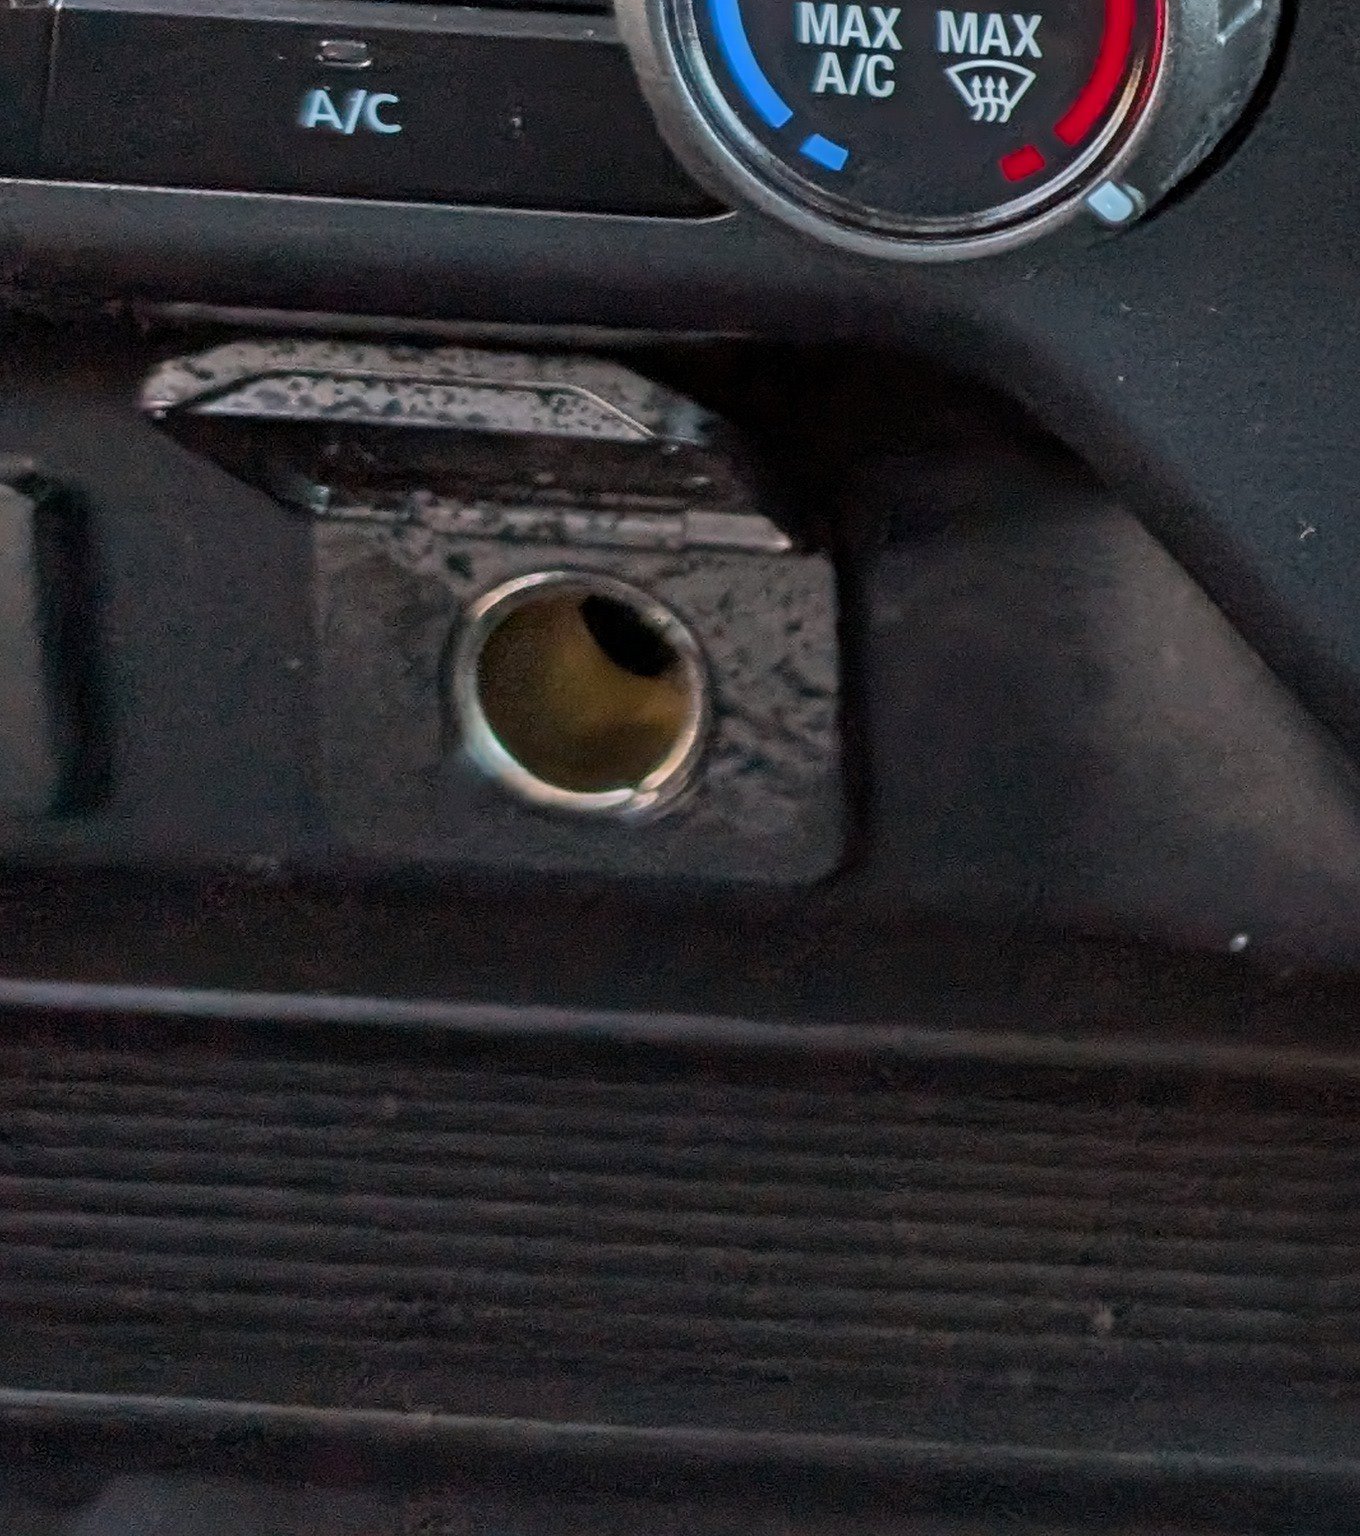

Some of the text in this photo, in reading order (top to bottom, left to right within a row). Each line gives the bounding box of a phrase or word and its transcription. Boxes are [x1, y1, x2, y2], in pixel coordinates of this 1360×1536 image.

[799, 0, 904, 52] MAX
[938, 9, 1043, 58] MAX
[814, 50, 898, 99] A/C
[300, 88, 403, 136] A/C
